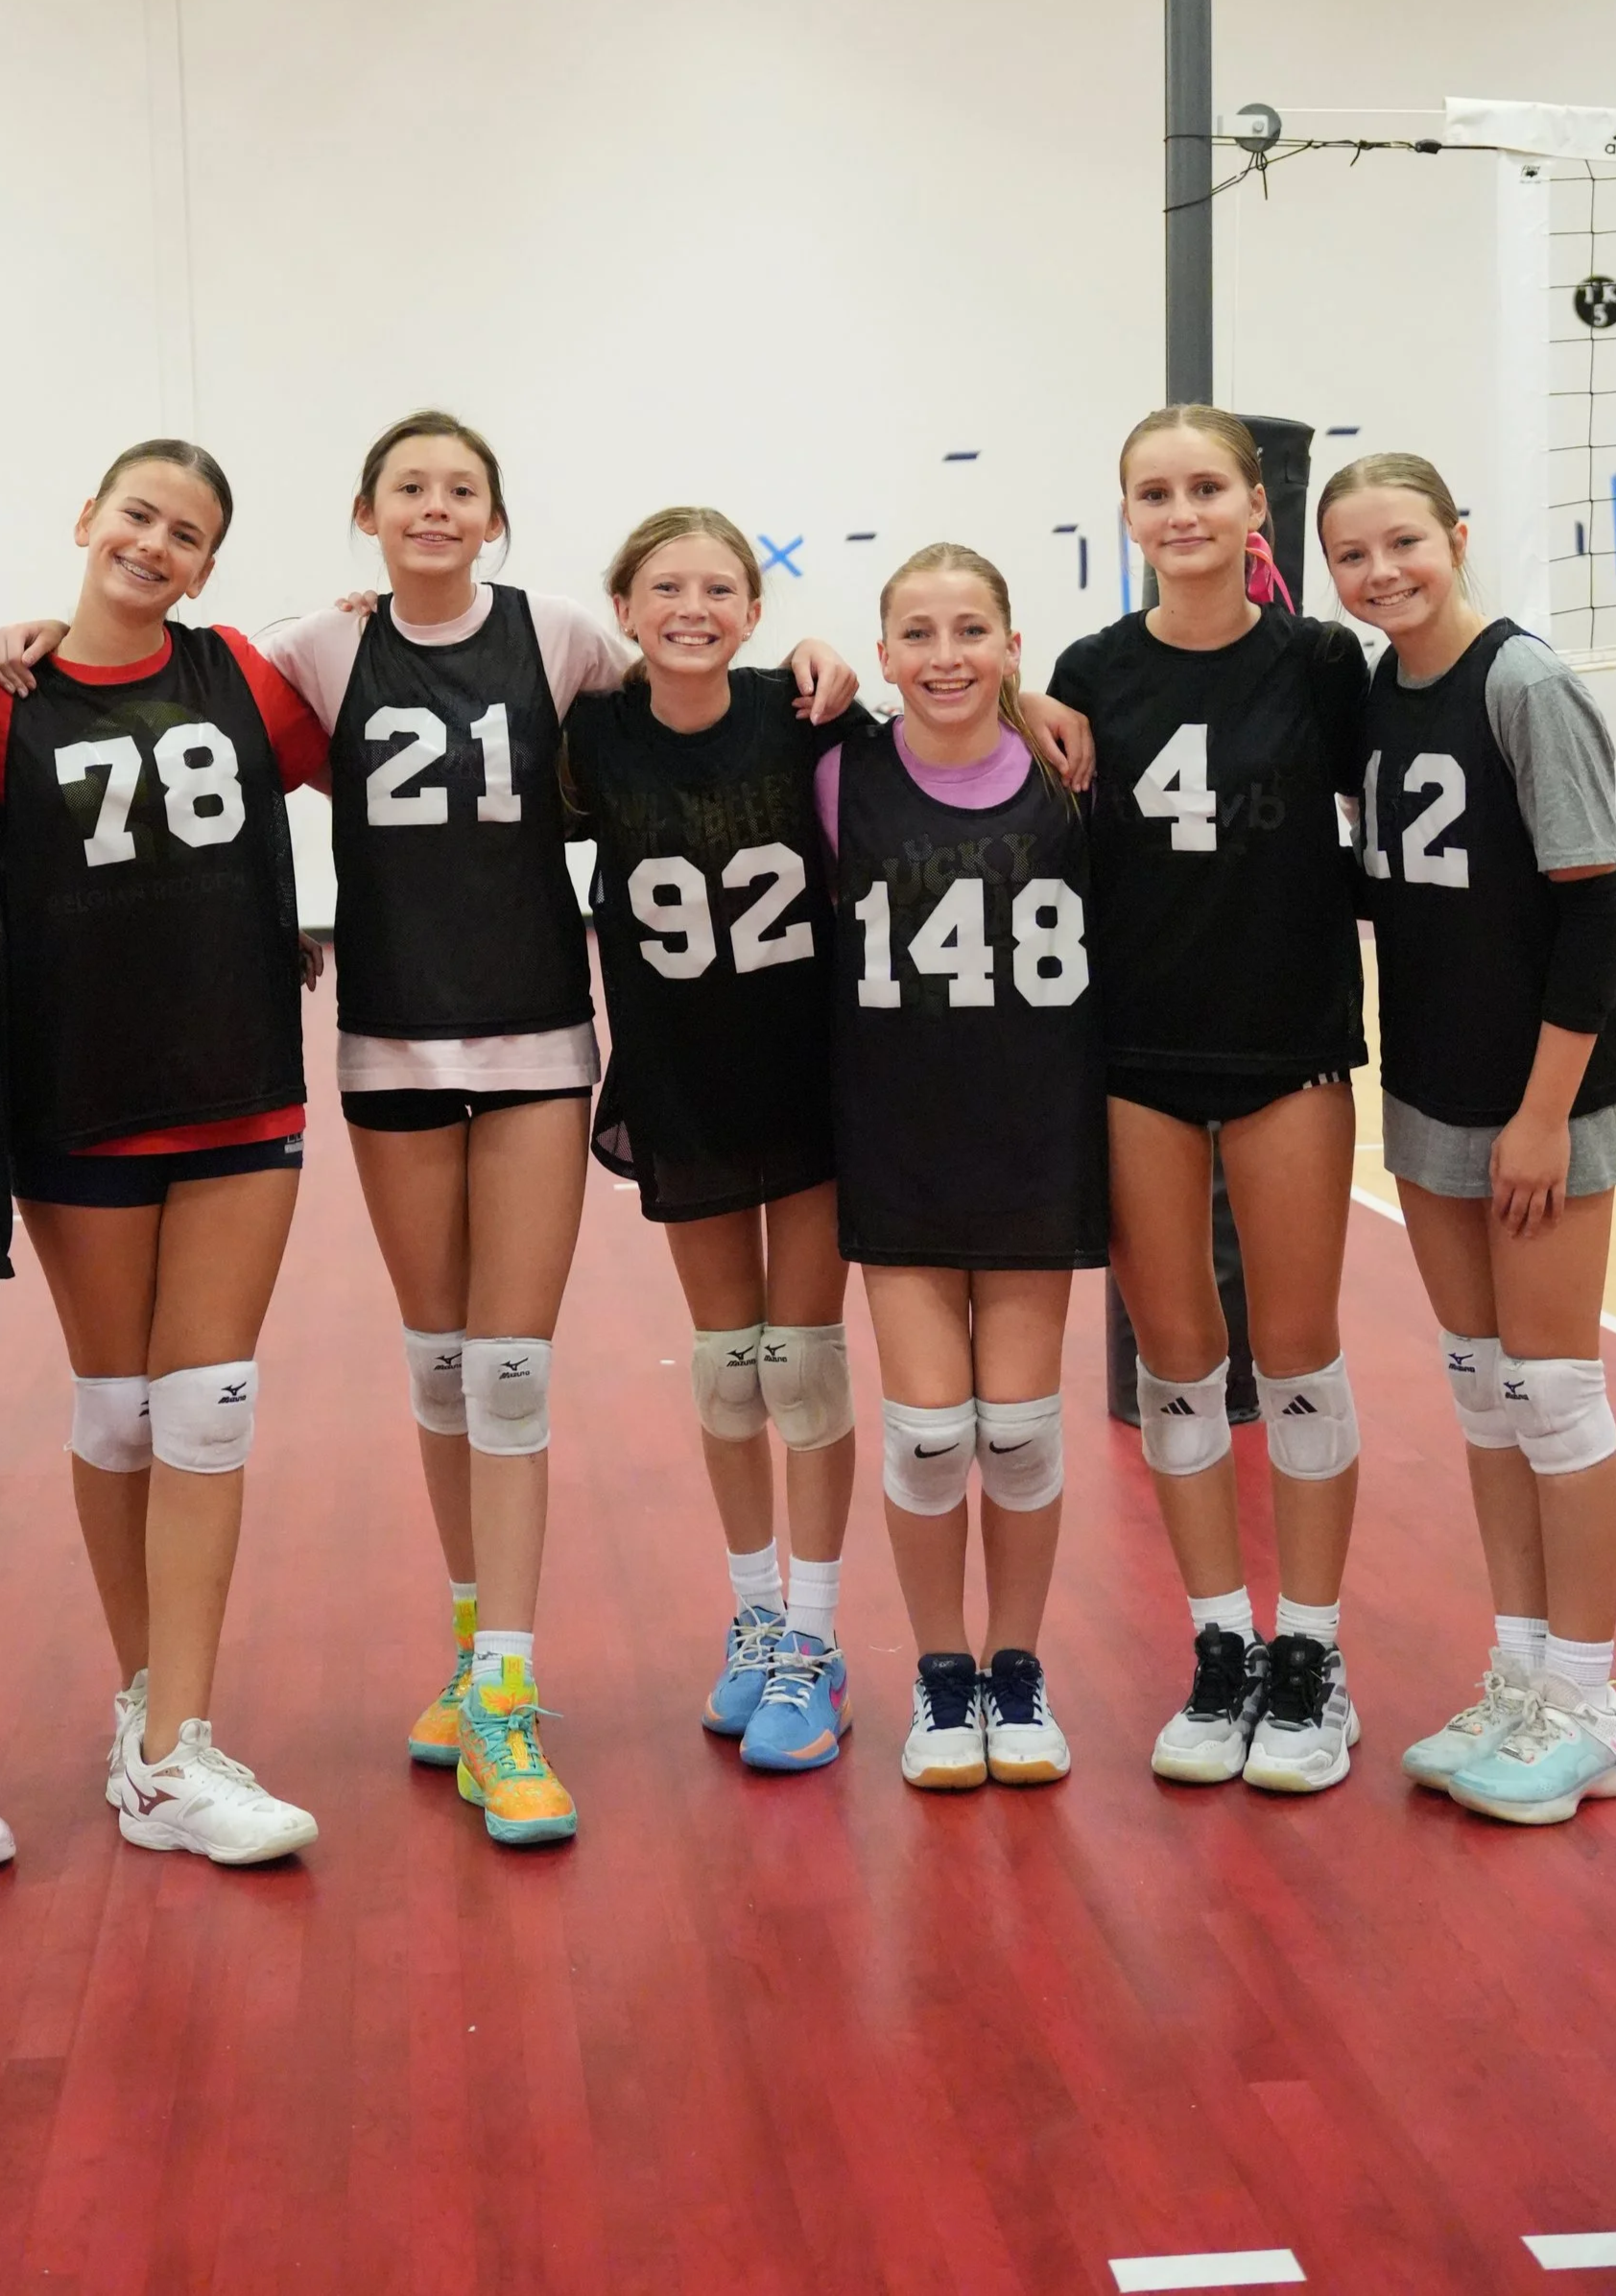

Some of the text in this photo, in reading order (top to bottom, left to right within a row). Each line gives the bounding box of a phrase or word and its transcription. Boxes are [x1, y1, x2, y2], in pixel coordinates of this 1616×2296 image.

[55, 722, 246, 867] 78
[365, 703, 522, 826] 21
[1133, 724, 1217, 852] 4
[1363, 749, 1470, 889] 12
[629, 842, 815, 979] 92
[856, 879, 1090, 1008] 148
